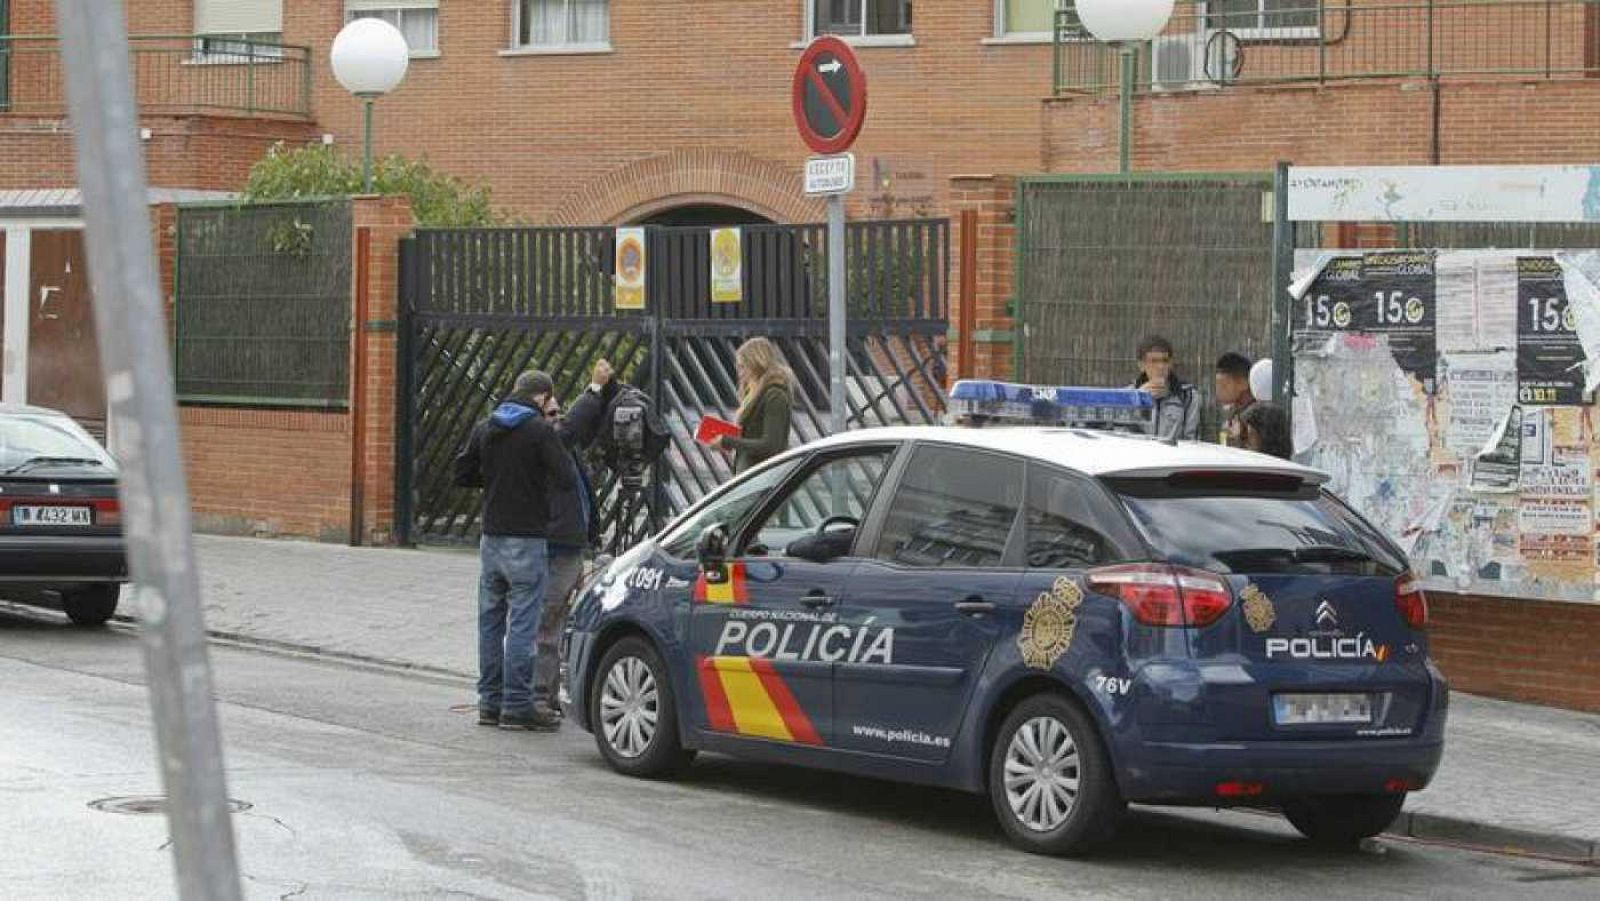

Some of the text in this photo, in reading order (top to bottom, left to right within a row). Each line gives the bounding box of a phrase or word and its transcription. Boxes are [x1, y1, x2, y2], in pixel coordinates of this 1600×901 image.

[714, 616, 895, 663] POLICÍA
[1265, 632, 1376, 659] POLICÍA
[853, 725, 950, 748] www.policia.es
